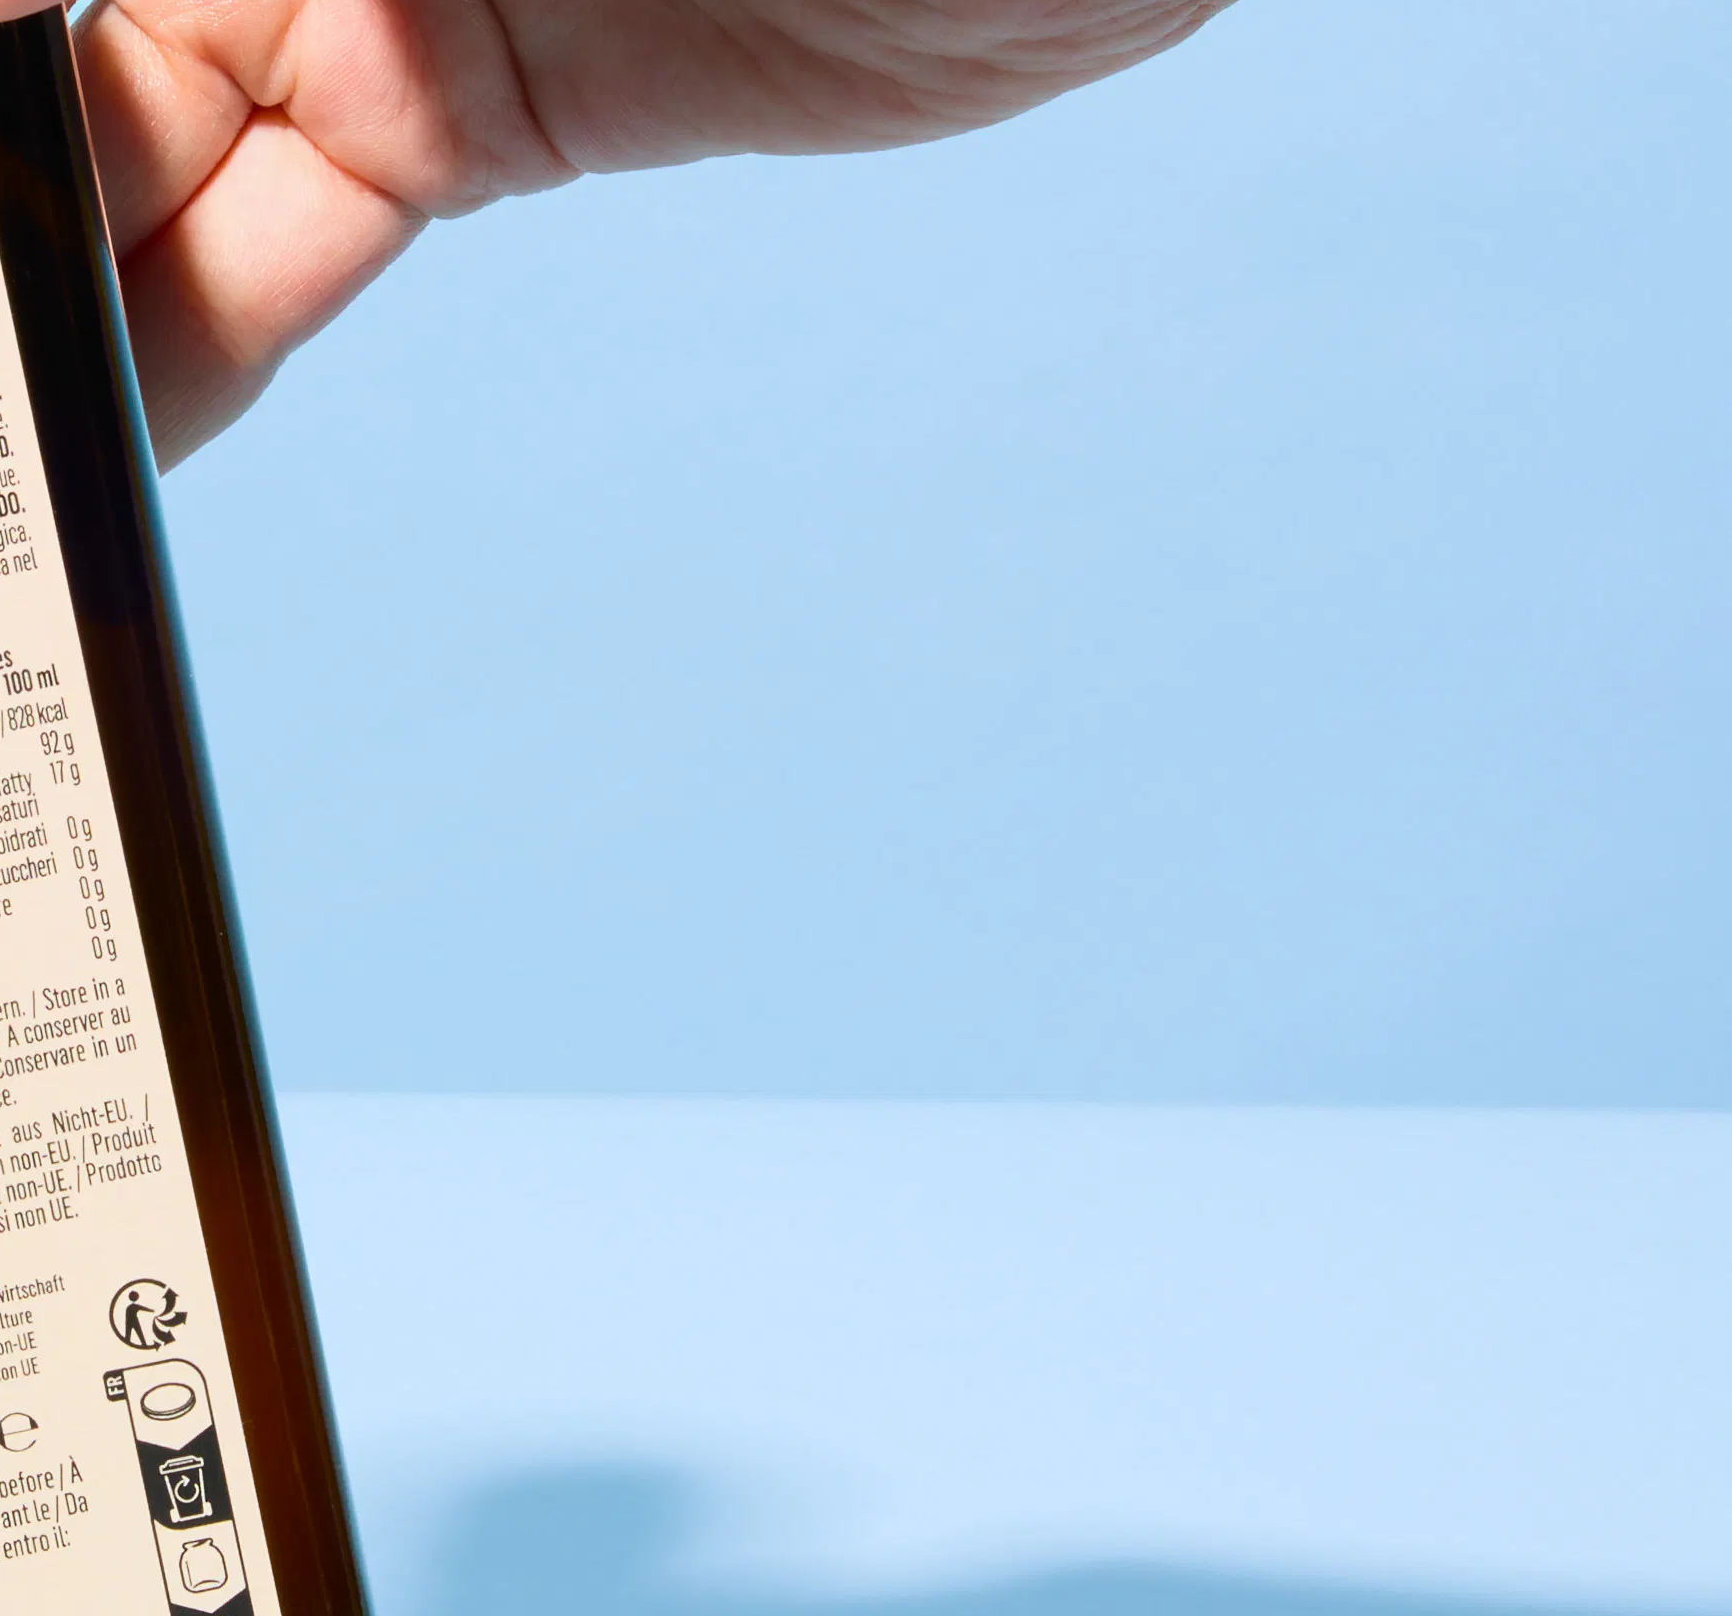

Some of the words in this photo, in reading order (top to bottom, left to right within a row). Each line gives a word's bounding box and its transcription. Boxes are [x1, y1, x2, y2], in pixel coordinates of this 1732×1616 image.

[6, 702, 36, 732] 828
[34, 696, 69, 725] kcal
[38, 728, 62, 756] 92
[62, 732, 75, 756] g
[65, 814, 79, 840] 0
[80, 817, 93, 842] g
[77, 874, 91, 900] 0
[92, 877, 106, 902] g
[84, 904, 98, 930] 0
[98, 907, 112, 932] g
[90, 935, 104, 960] 0
[105, 937, 118, 962] g
[41, 985, 89, 1012] Store
[91, 977, 110, 1001] in
[114, 977, 126, 996] a
[10, 1120, 43, 1144] aus
[50, 1097, 133, 1135] Nicht-EU.
[19, 1355, 41, 1377] UE
[68, 1455, 84, 1484] À
[31, 1498, 51, 1522] le
[63, 1491, 89, 1516] Da
[1, 1533, 51, 1560] entro
[51, 1524, 71, 1549] il:
